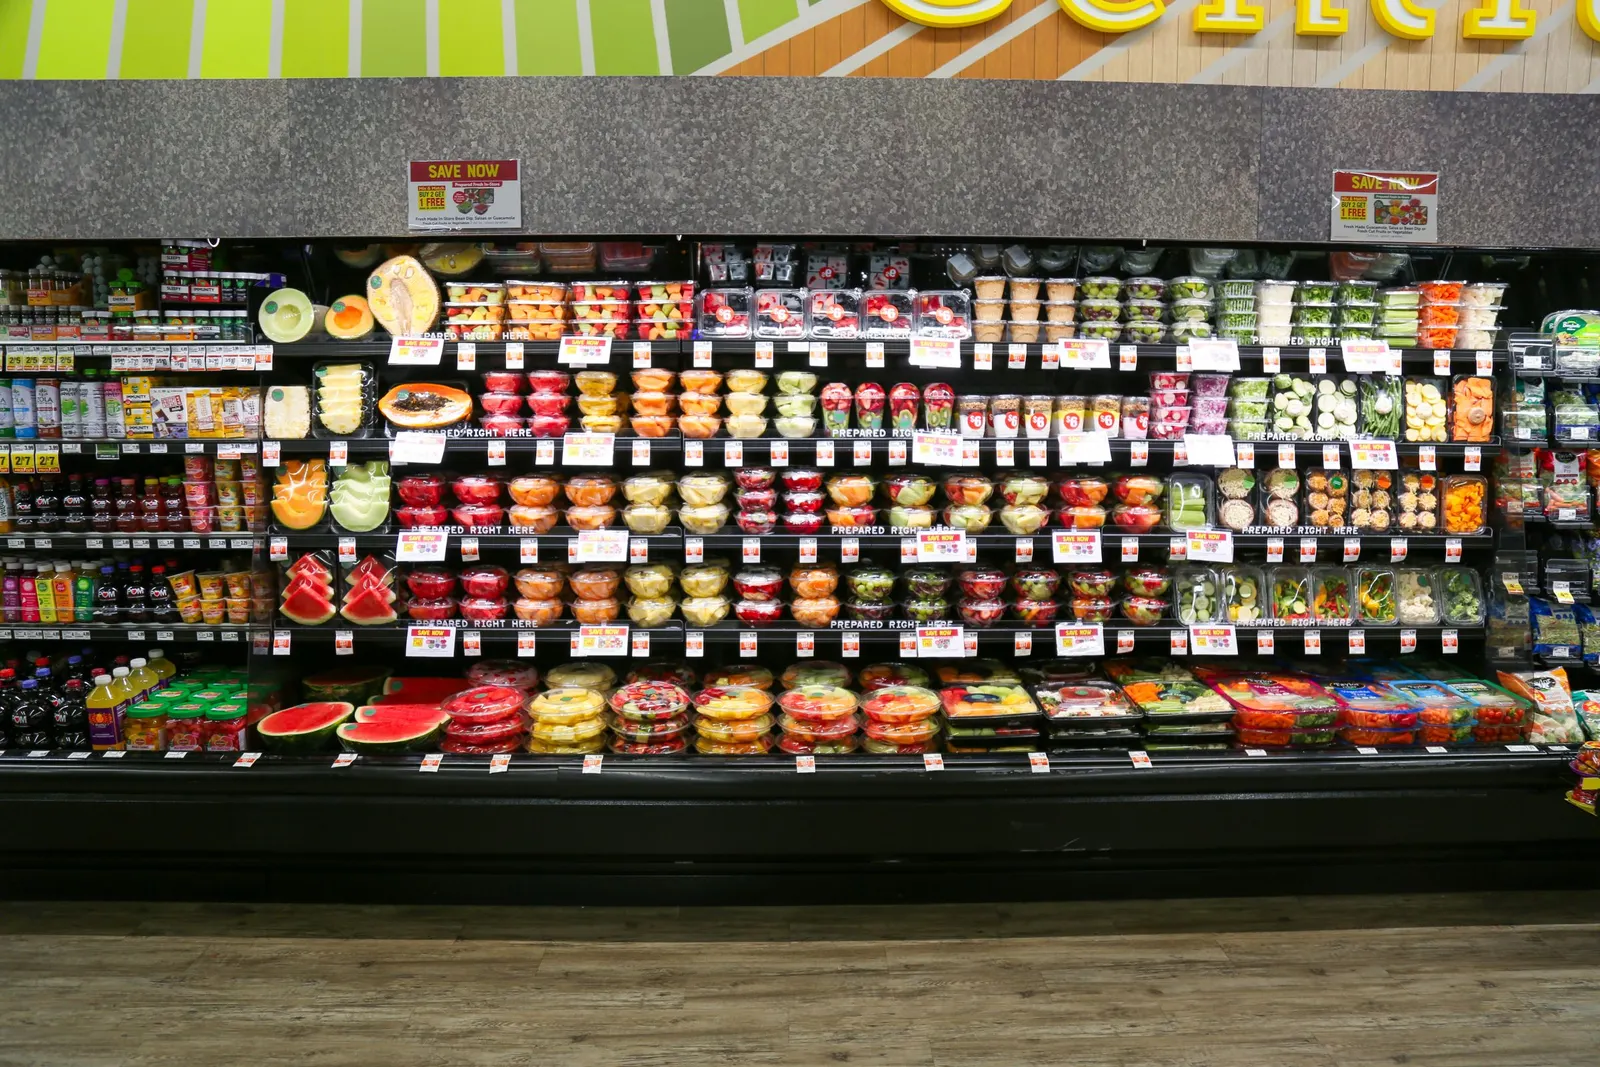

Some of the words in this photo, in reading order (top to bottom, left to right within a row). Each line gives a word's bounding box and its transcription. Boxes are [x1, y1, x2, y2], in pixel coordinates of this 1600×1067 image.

[428, 164, 461, 178] SAVE
[467, 163, 499, 178] NOW
[1351, 175, 1383, 190] SAVE
[1388, 177, 1420, 190] NOW
[419, 198, 424, 207] 1
[426, 198, 445, 207] FREE
[1341, 208, 1345, 217] 1
[1348, 208, 1366, 217] FREE
[720, 308, 731, 321] $6
[773, 307, 786, 320] $6
[940, 309, 951, 322] $6
[403, 332, 457, 340] PPARED
[463, 332, 496, 341] RIGHT
[502, 332, 529, 340] HERE
[1310, 337, 1341, 346] RIGHT
[969, 415, 982, 427] $6
[1008, 414, 1018, 427] $6
[1032, 415, 1045, 428] $6
[1065, 415, 1078, 428] $6
[1099, 414, 1113, 427] $6
[407, 429, 460, 437] PARED
[466, 428, 499, 438] RIGHT
[505, 429, 532, 438] HERE
[832, 428, 886, 438] PREPARED
[1247, 432, 1298, 441] PREPARED
[470, 526, 502, 534] RIGHT
[508, 526, 535, 534] HERE
[831, 526, 885, 535] PREPARED
[891, 526, 923, 534] RIGHT
[1242, 526, 1293, 534] PREPARED
[1297, 526, 1328, 534] RIGHT
[1333, 526, 1359, 535] HERE
[98, 589, 116, 598] POM
[126, 587, 145, 596] POM
[150, 589, 168, 598] POM
[416, 619, 468, 628] PREPARED
[475, 619, 506, 628] RIGHT
[512, 620, 538, 628] HERE
[830, 620, 883, 629] PREPARED
[889, 620, 921, 629] RIGHT
[1236, 618, 1286, 627] PREPARED
[1291, 618, 1322, 627] RIGHT
[1327, 618, 1352, 627] HERE
